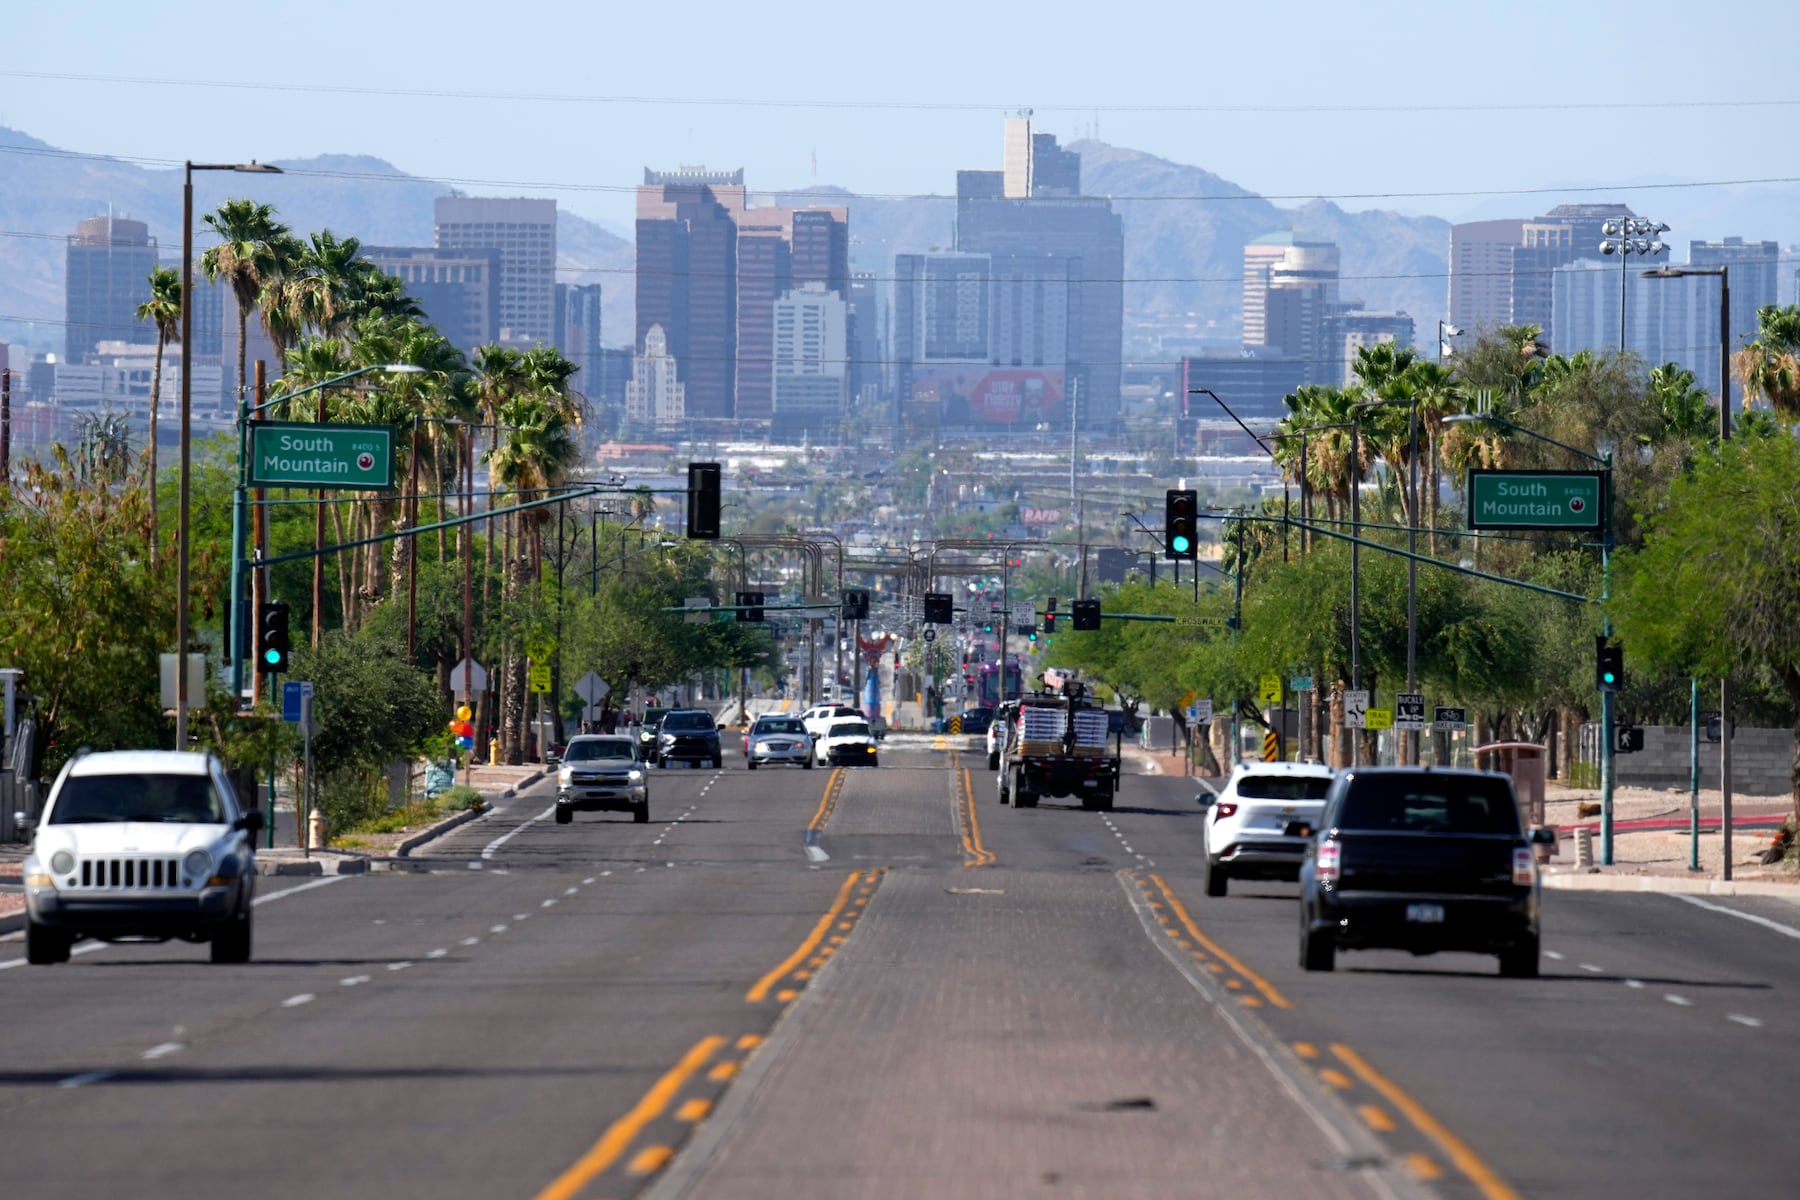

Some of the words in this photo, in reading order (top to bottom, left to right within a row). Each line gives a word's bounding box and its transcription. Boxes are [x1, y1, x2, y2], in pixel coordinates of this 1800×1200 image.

[280, 435, 334, 452] South
[264, 455, 349, 473] Mountain
[1498, 482, 1547, 496] South
[1483, 501, 1561, 516] Mountain
[1398, 696, 1424, 704] BUCKLE
